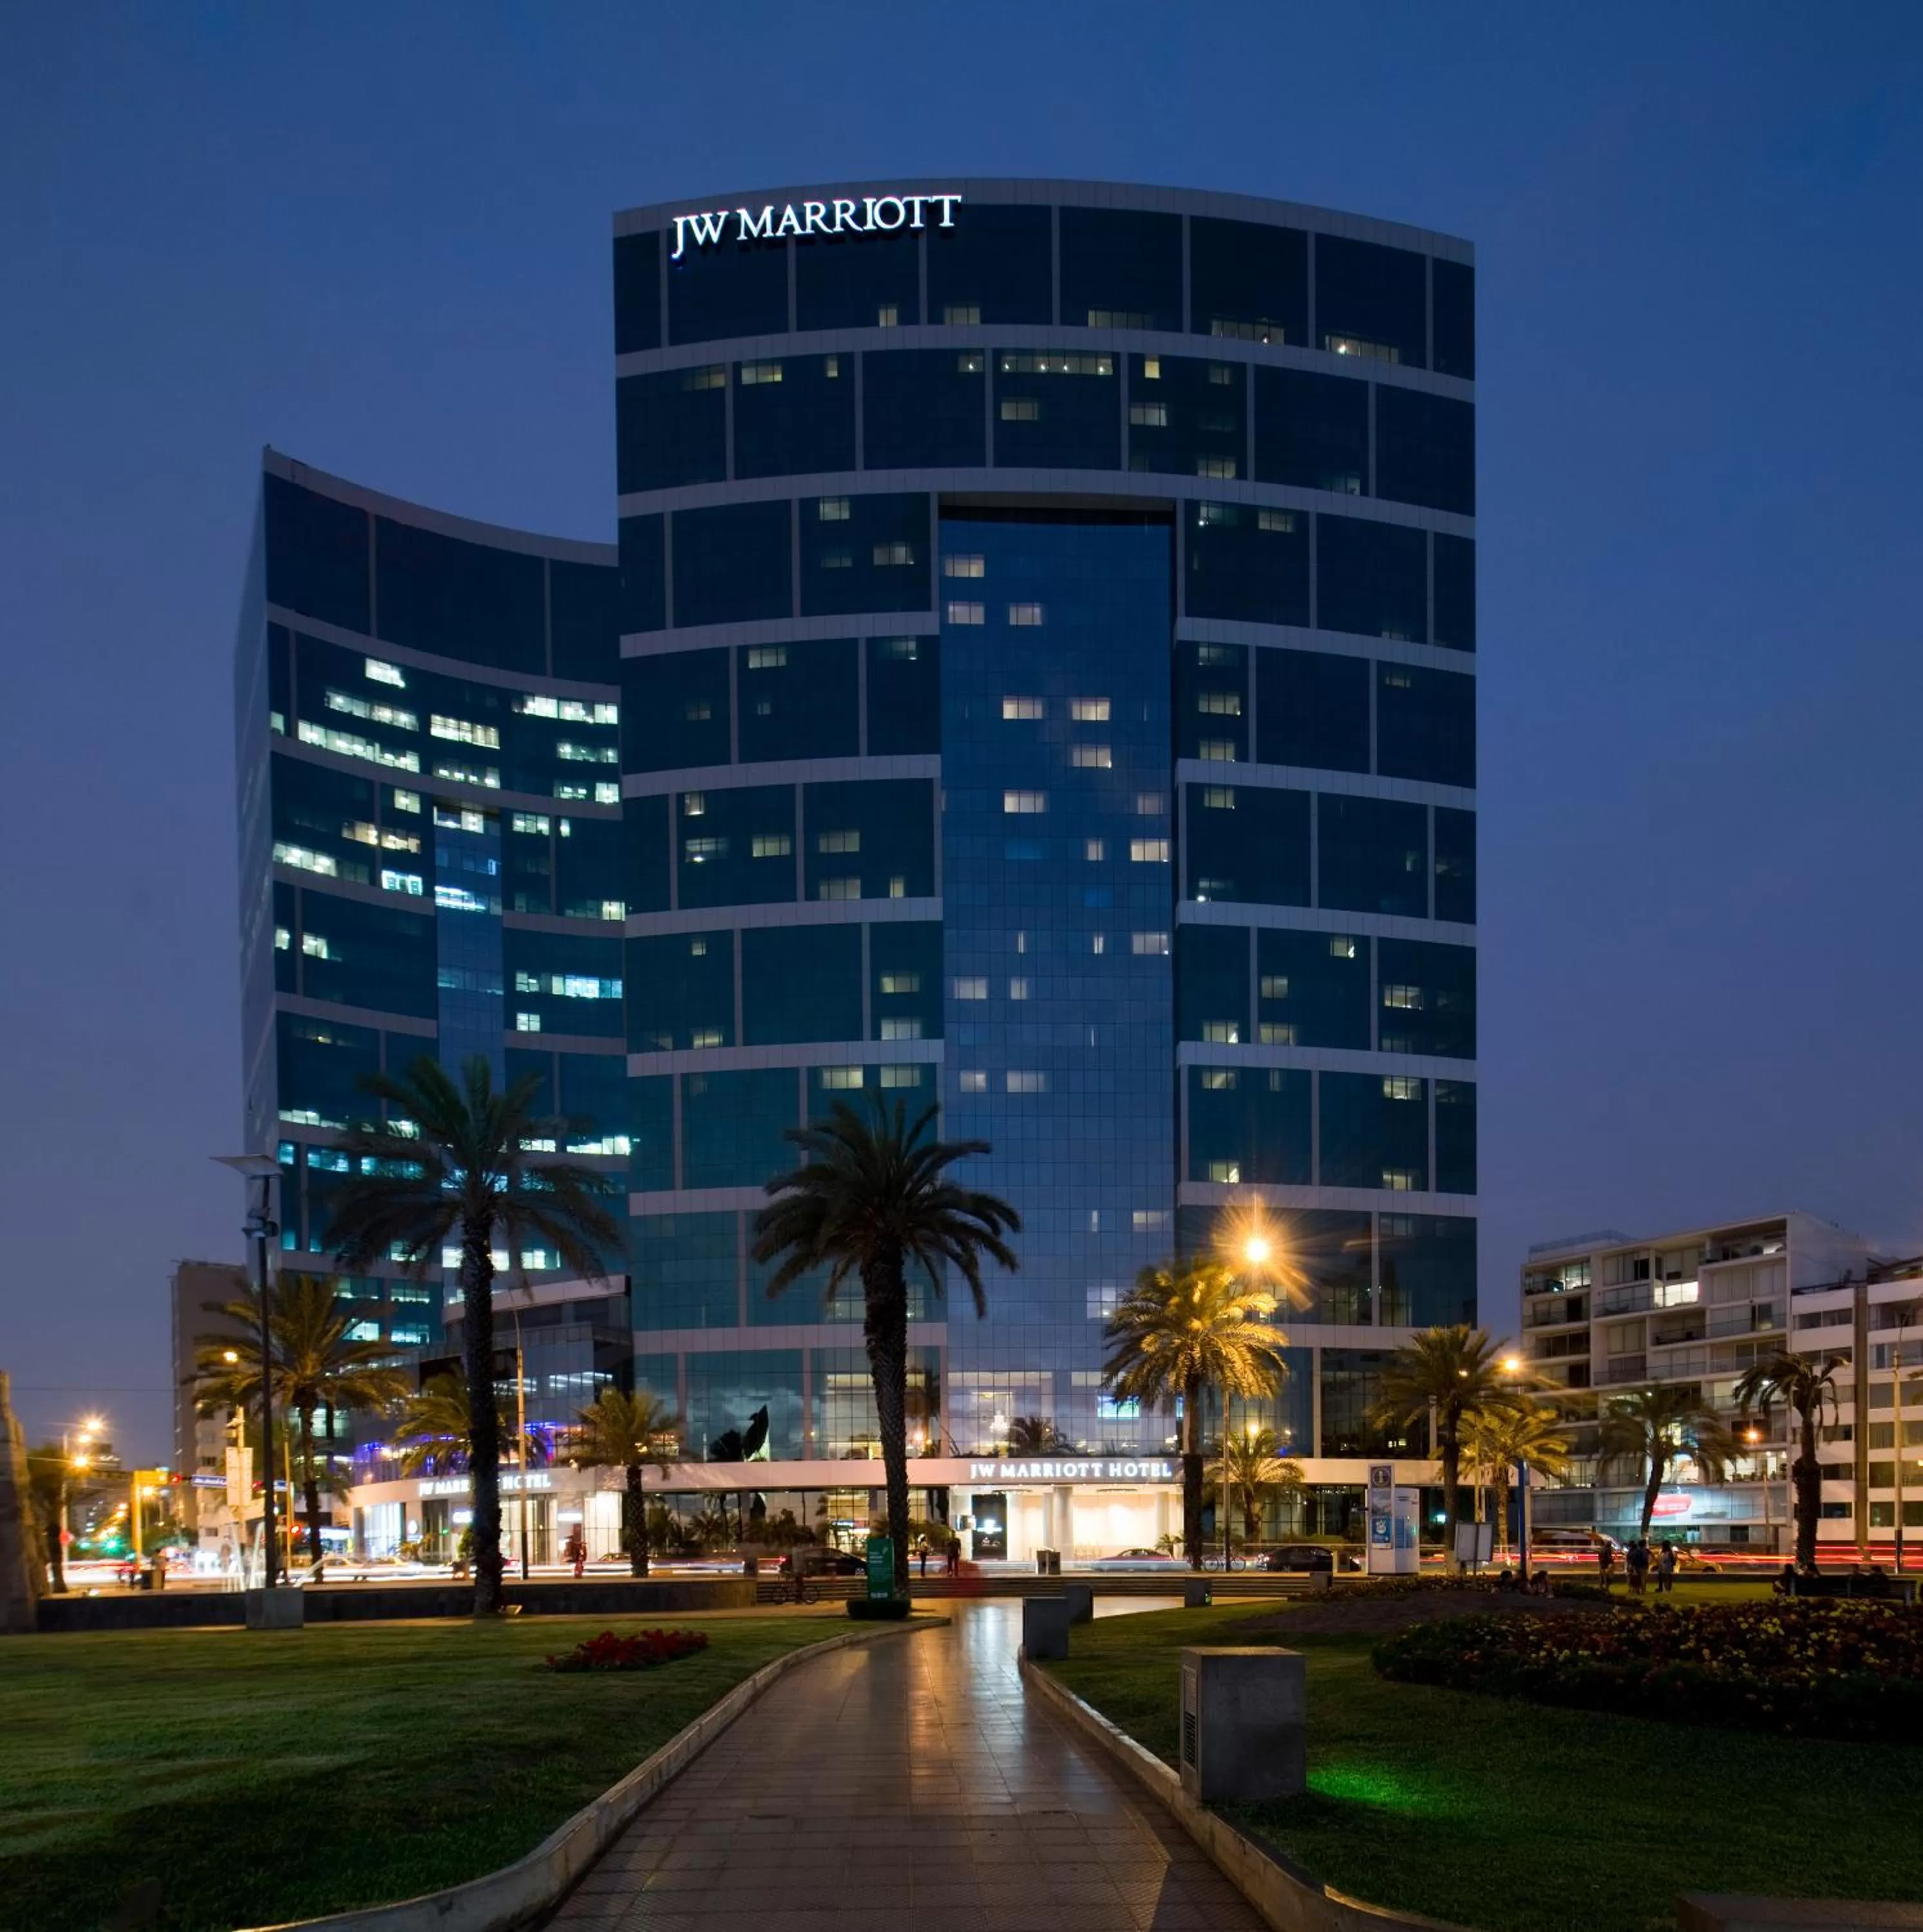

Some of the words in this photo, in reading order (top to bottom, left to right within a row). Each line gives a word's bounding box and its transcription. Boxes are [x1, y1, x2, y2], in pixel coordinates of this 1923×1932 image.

[672, 211, 730, 260] JW
[736, 195, 962, 240] MARRIOTT
[971, 1463, 996, 1479] JW
[1000, 1463, 1103, 1478] MARRIOTT
[1109, 1462, 1173, 1477] HOTEL
